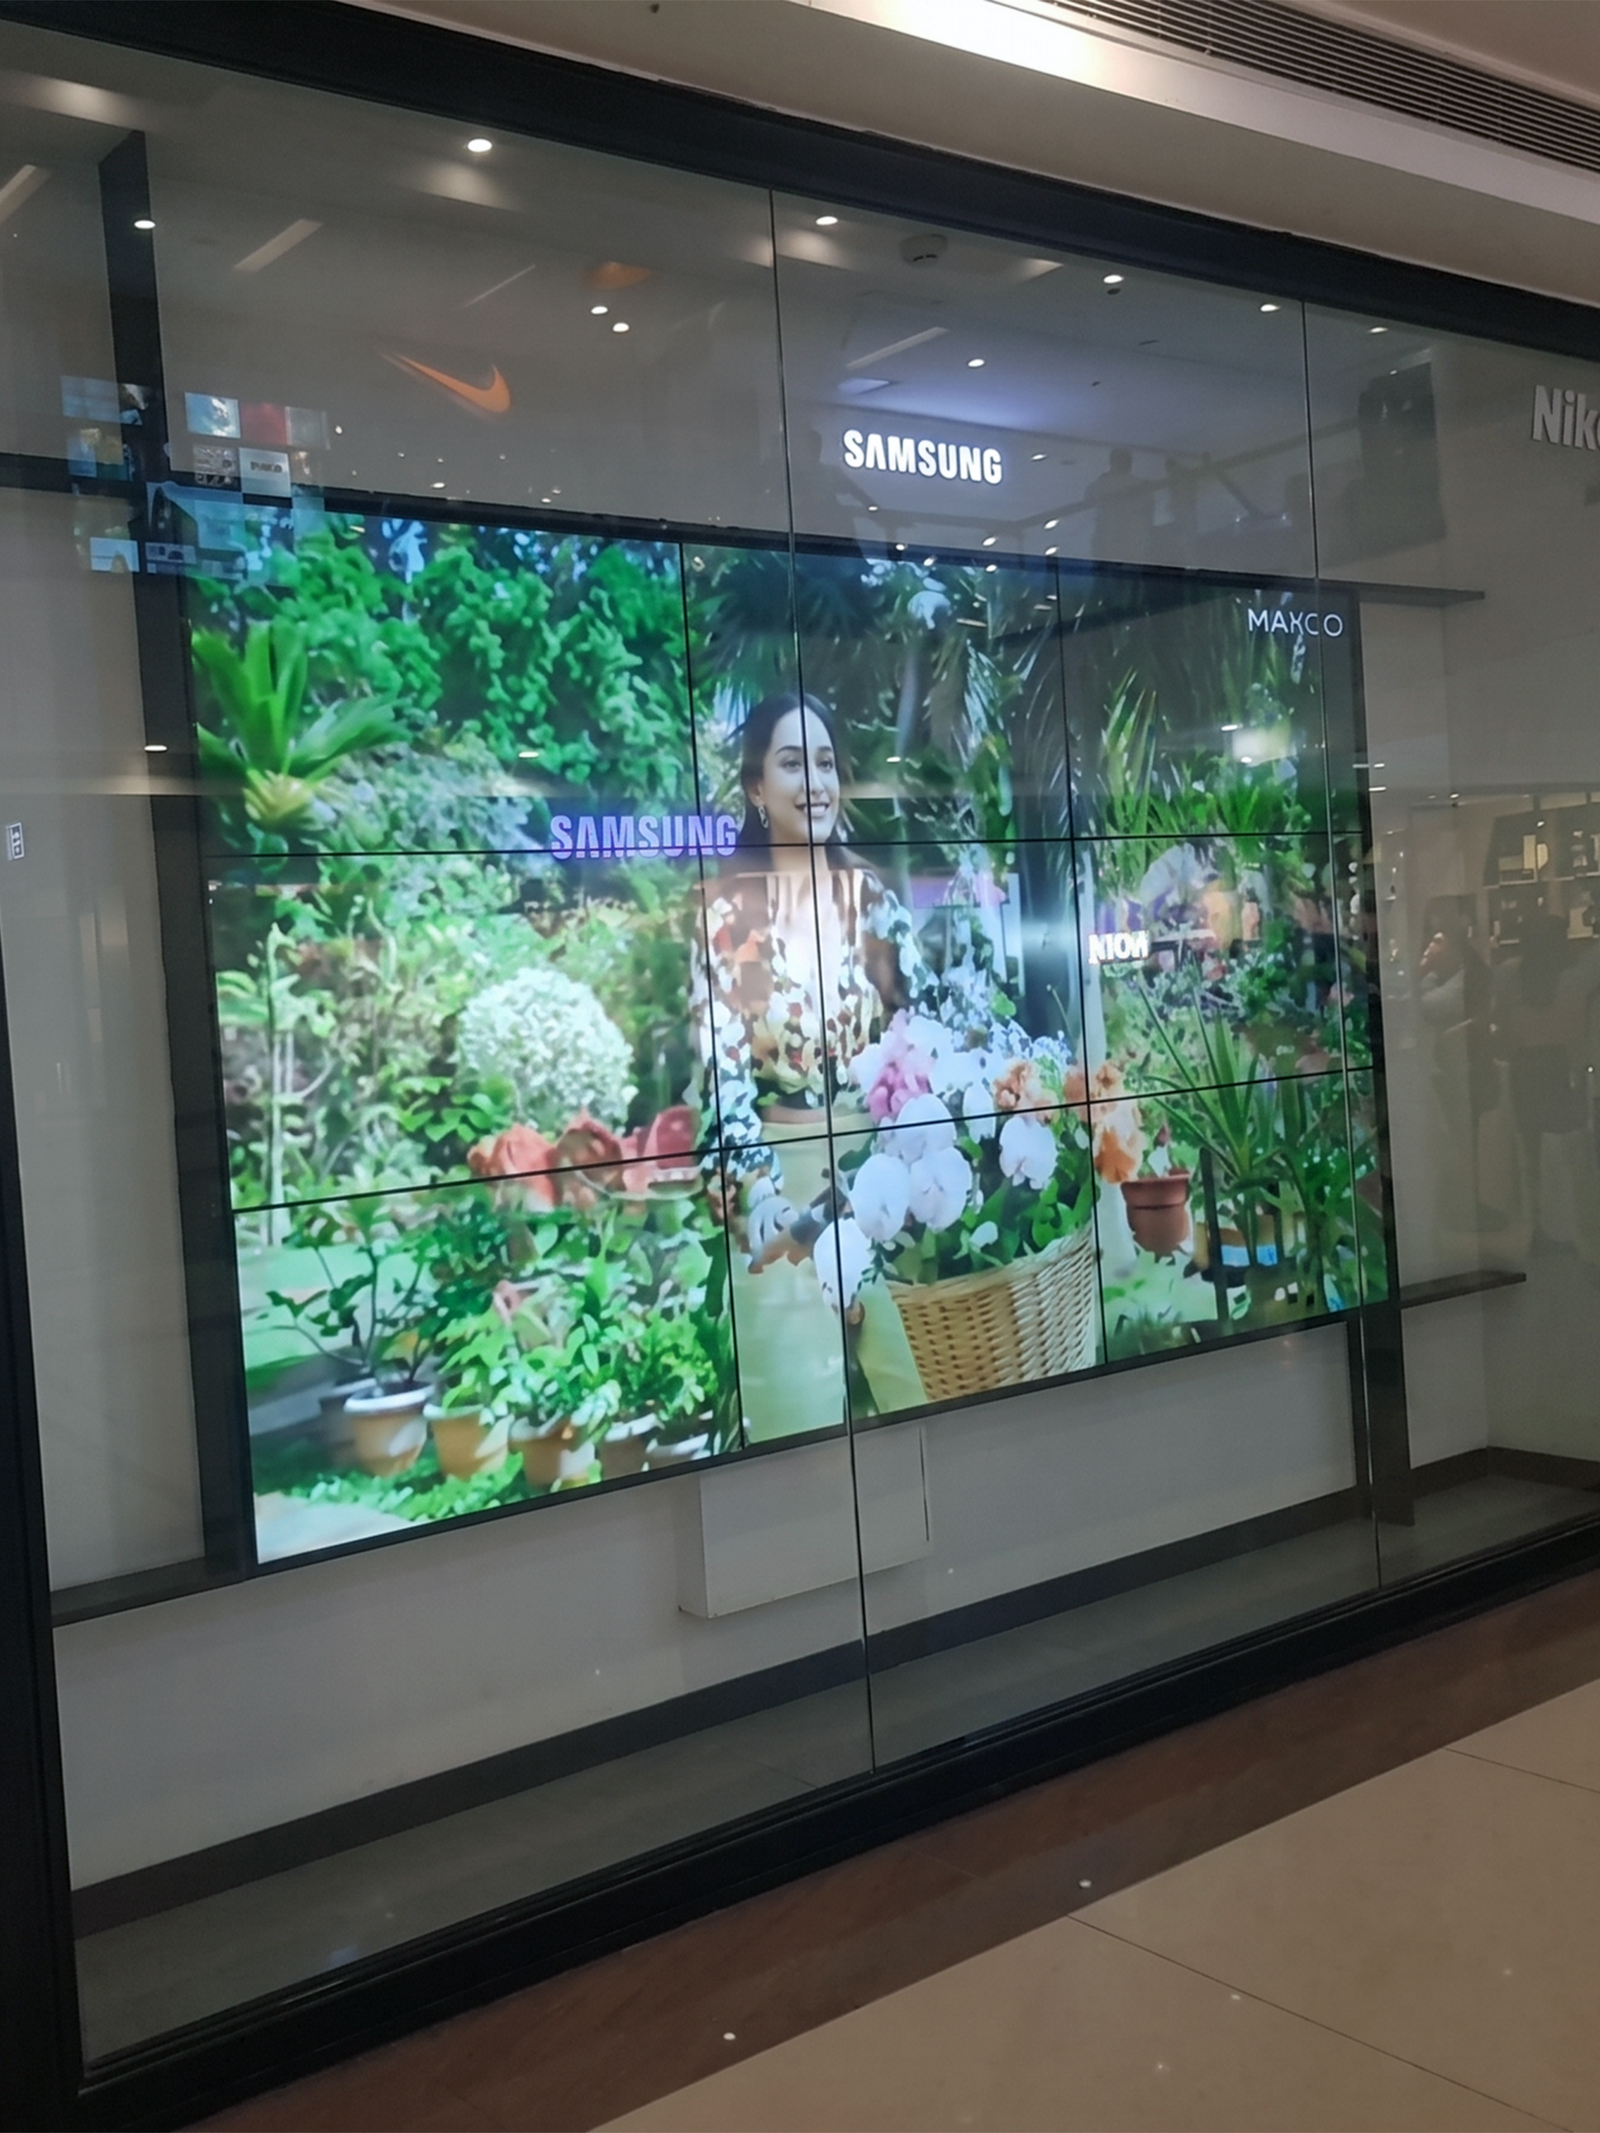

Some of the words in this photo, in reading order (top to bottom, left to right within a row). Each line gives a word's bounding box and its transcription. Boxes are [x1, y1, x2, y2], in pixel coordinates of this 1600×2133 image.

[1531, 384, 1600, 450] Nik
[843, 429, 1002, 484] SAMSUNG
[550, 815, 736, 859] SAMSUNG
